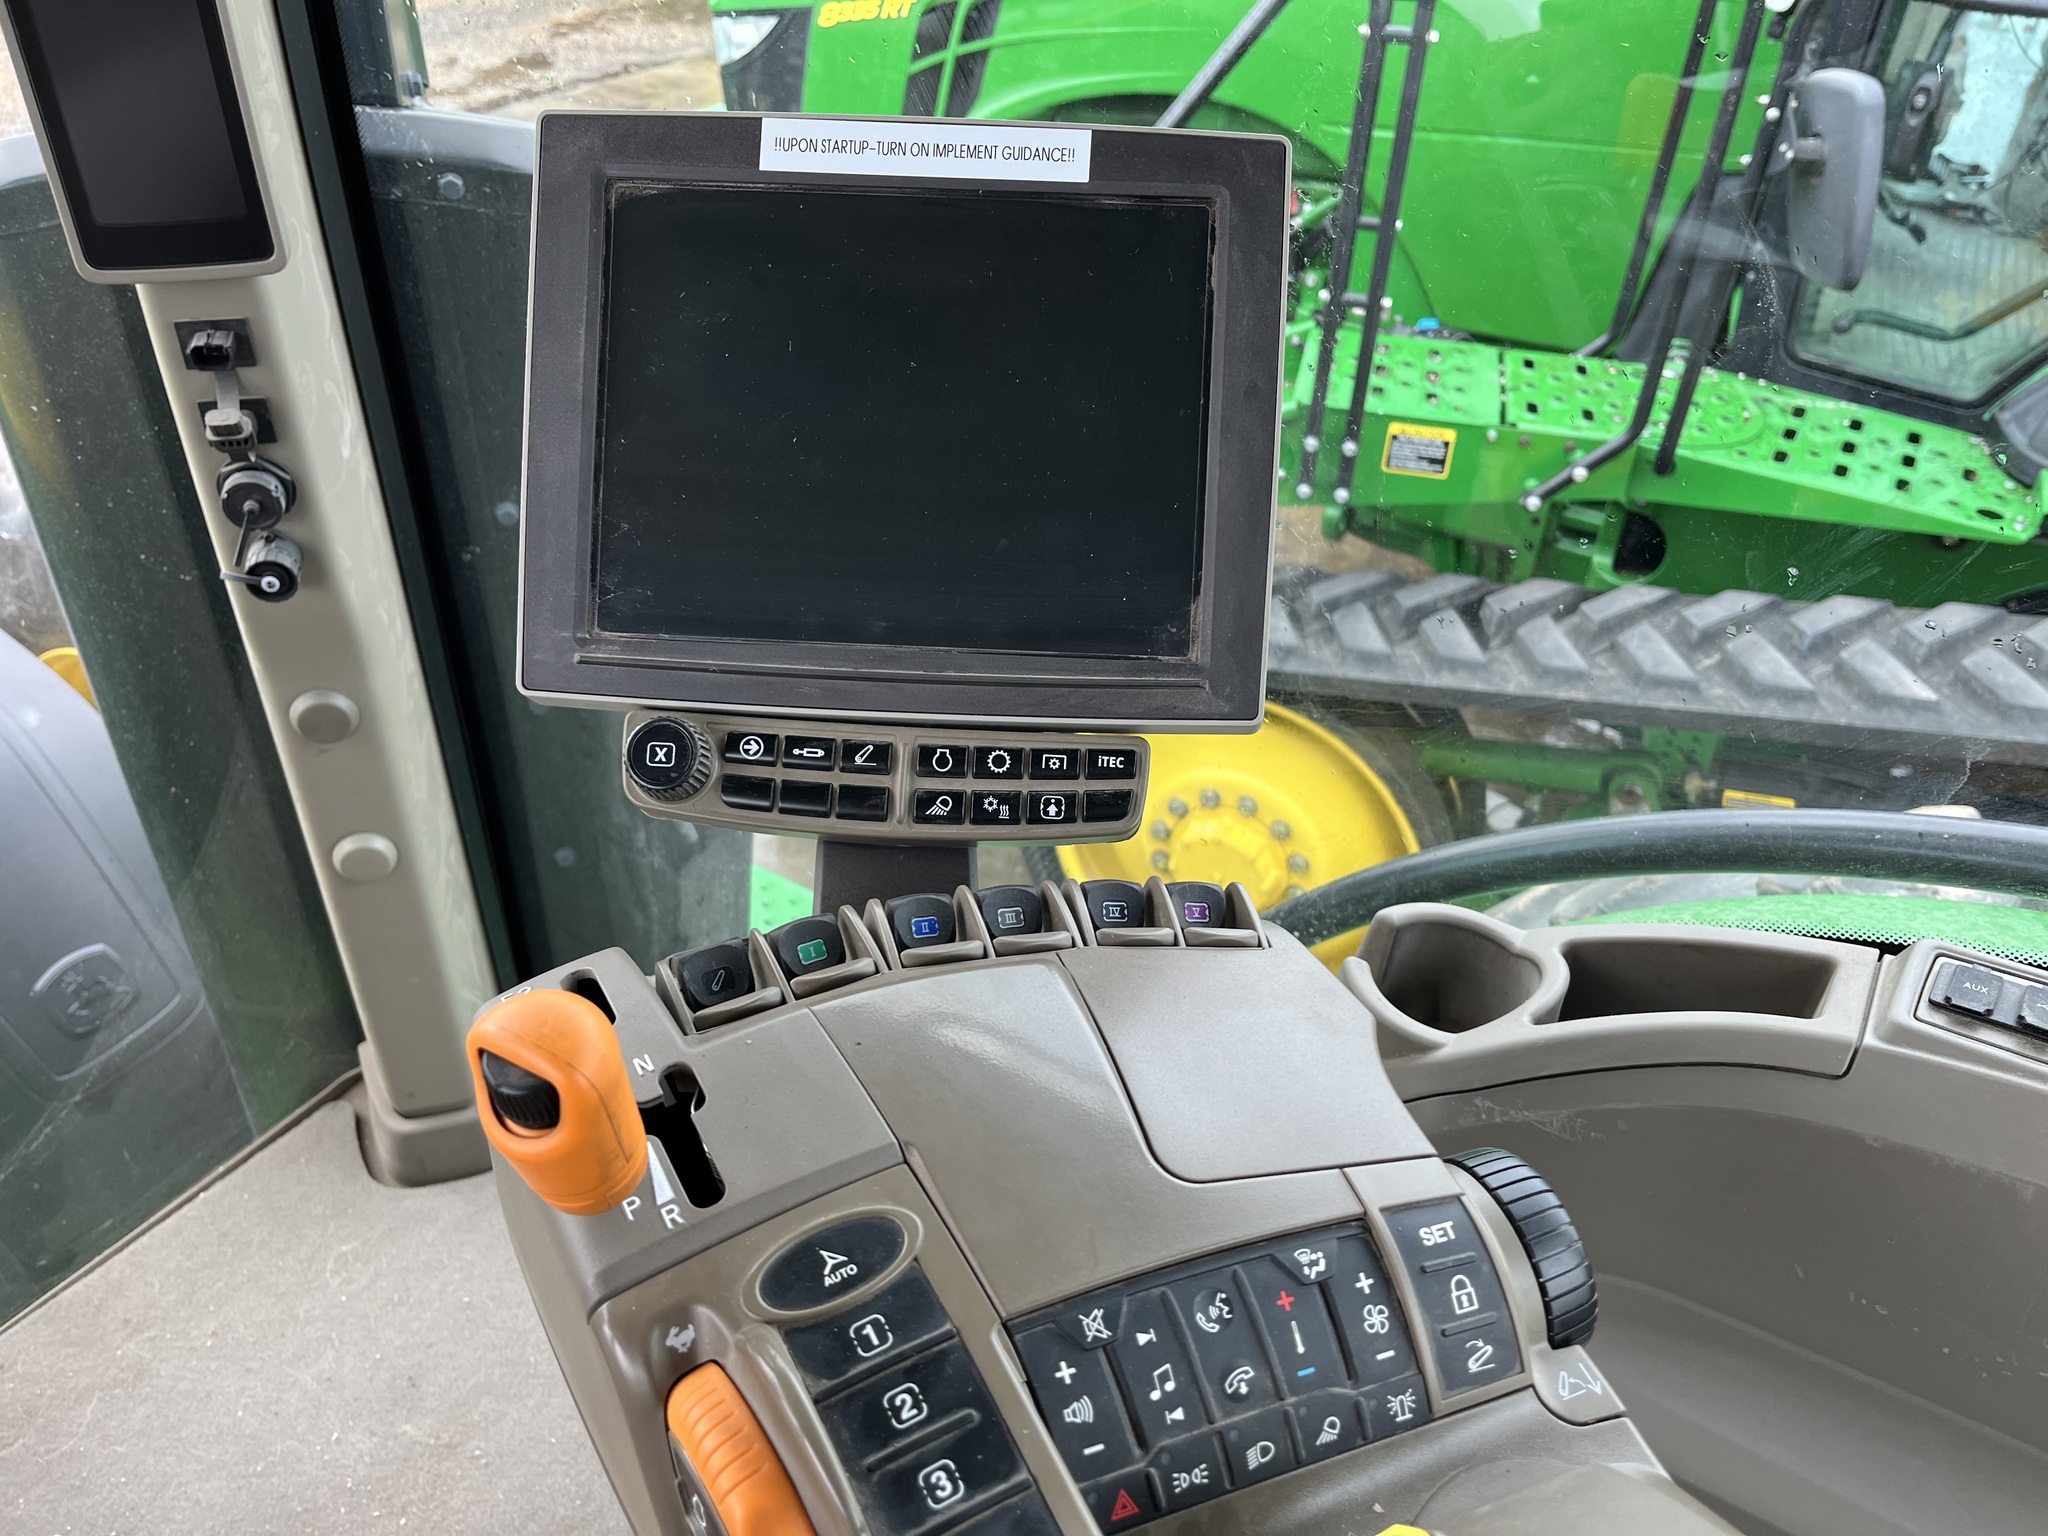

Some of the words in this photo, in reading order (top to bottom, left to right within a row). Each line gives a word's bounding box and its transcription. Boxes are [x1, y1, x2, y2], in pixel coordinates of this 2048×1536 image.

[774, 136, 818, 153] !!UPON
[910, 142, 930, 157] ON
[932, 142, 999, 160] IMPLEMENT
[1001, 145, 1076, 163] GUIDANCE!!
[1097, 755, 1125, 769] iTEC
[1962, 981, 1990, 995] AUX
[632, 1053, 655, 1076] N
[622, 1195, 641, 1222] P
[659, 1203, 686, 1230] R
[1418, 1220, 1456, 1247] SET
[823, 1263, 858, 1288] AUTO
[861, 1323, 879, 1346] 1
[894, 1392, 918, 1421] 2
[930, 1469, 953, 1498] 3
